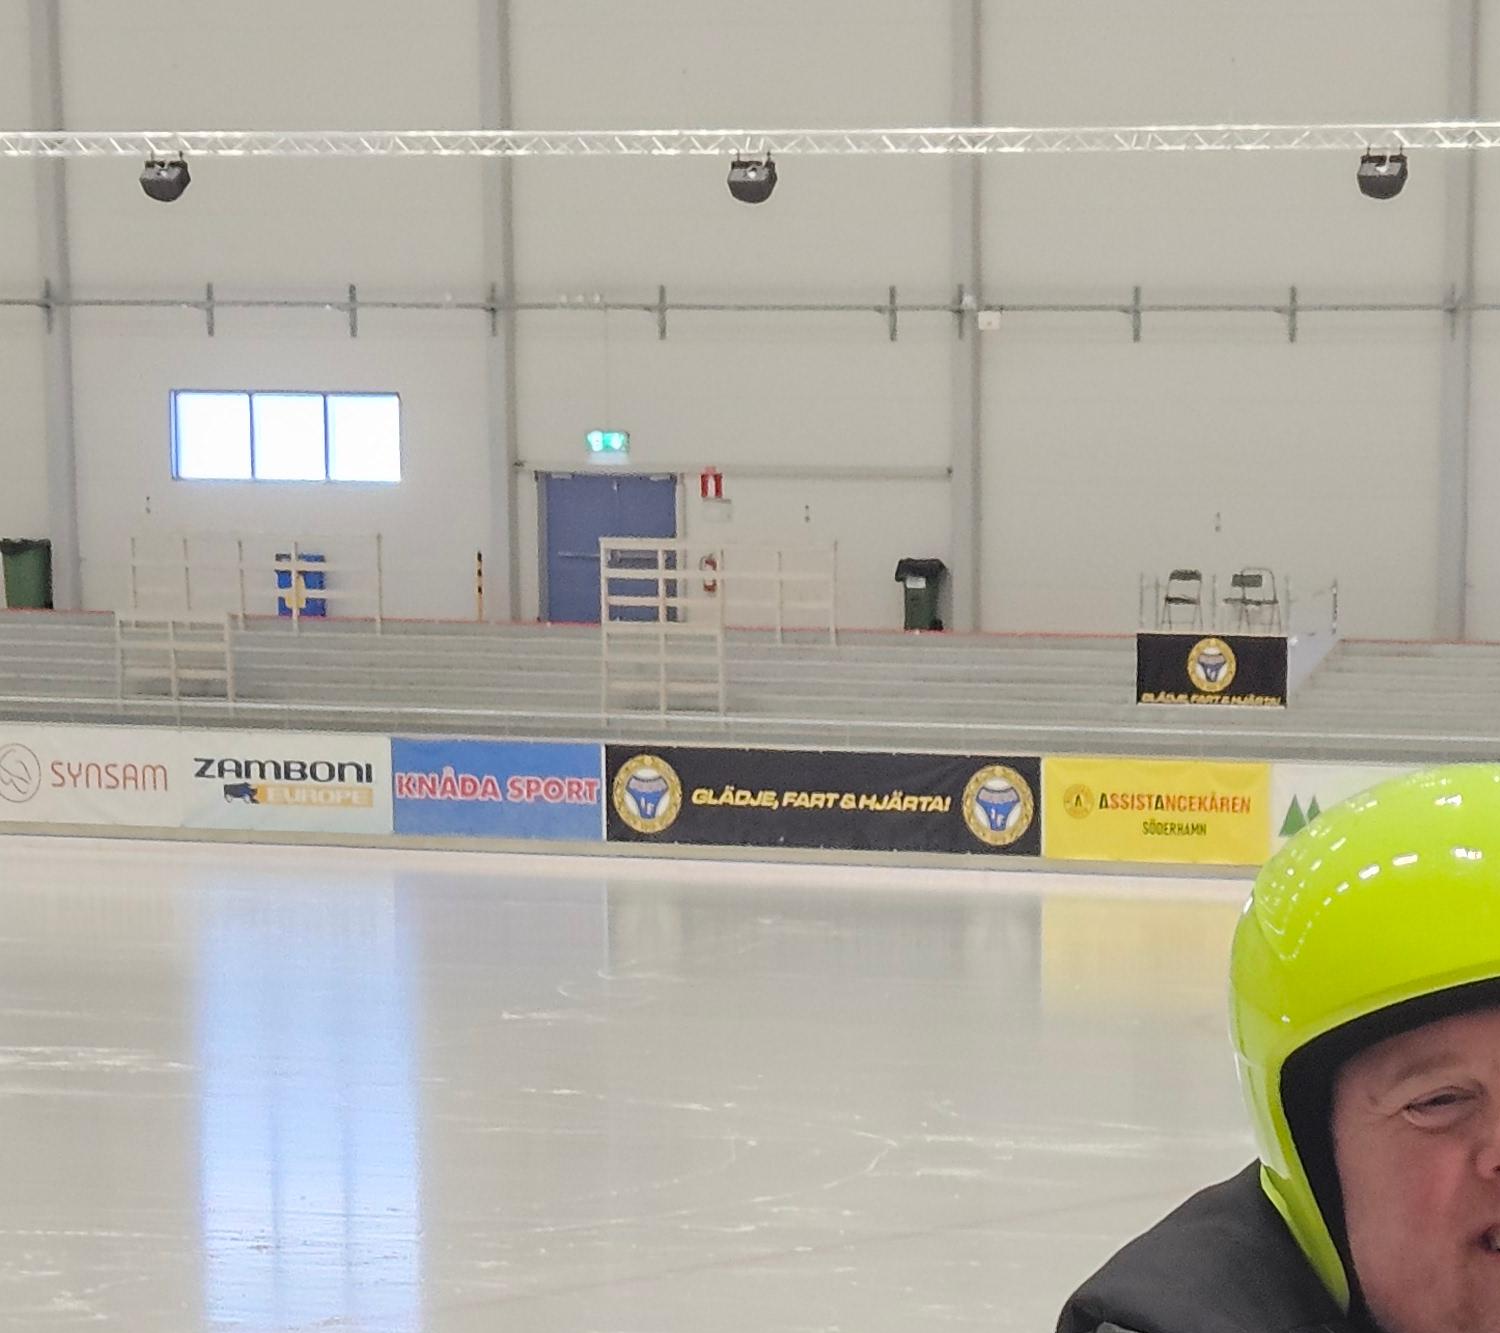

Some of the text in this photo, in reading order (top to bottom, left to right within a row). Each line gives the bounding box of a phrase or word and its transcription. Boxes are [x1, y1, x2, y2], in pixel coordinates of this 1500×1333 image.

[51, 760, 168, 791] SYNSAM
[194, 757, 373, 783] ZAMBONI
[267, 787, 370, 805] EUROPE
[395, 766, 600, 804] KNÅDA SPORT
[781, 791, 840, 809] FART
[1099, 792, 1251, 814] ASSISTANCEKÅREN
[1142, 818, 1207, 836] SÖDERHAMN
